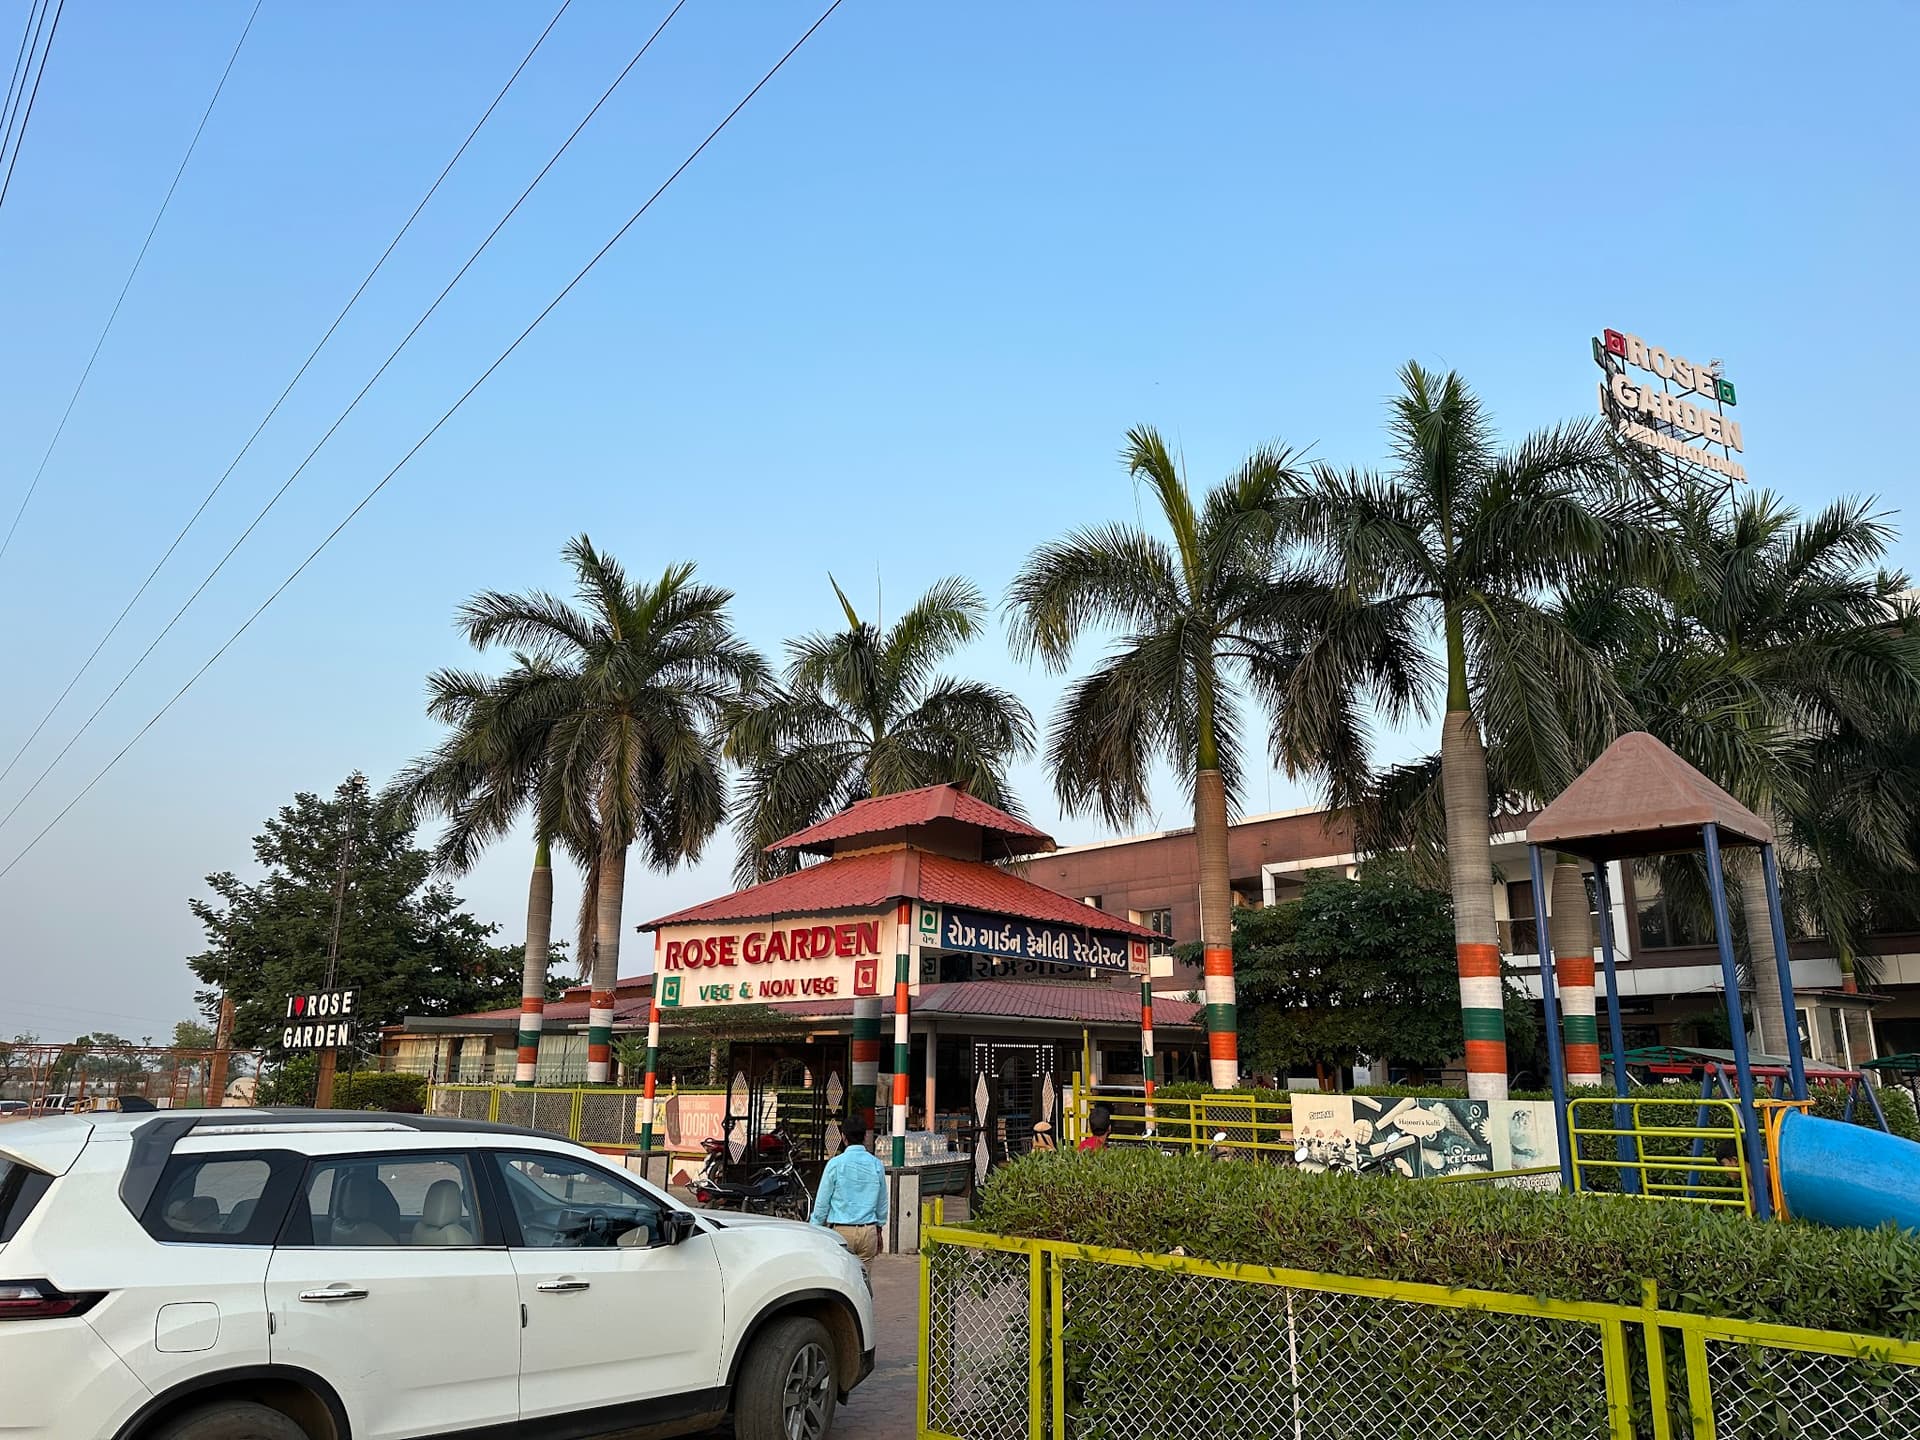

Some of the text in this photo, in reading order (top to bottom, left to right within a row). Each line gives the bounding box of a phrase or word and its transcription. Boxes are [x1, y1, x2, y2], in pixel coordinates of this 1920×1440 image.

[1626, 333, 1717, 399] ROSE
[1611, 374, 1743, 453] GARDEN
[665, 920, 881, 969] ROSE GARDEN
[948, 915, 976, 947] રોઝ
[979, 923, 1021, 954] ગાર્ડન
[1026, 926, 1069, 960] ફેમીલી
[307, 991, 352, 1017] ROSE
[700, 976, 838, 1000] VEG & NON VEG
[283, 1023, 348, 1048] GARDEN
[1446, 1153, 1489, 1164] ICE CREAM
